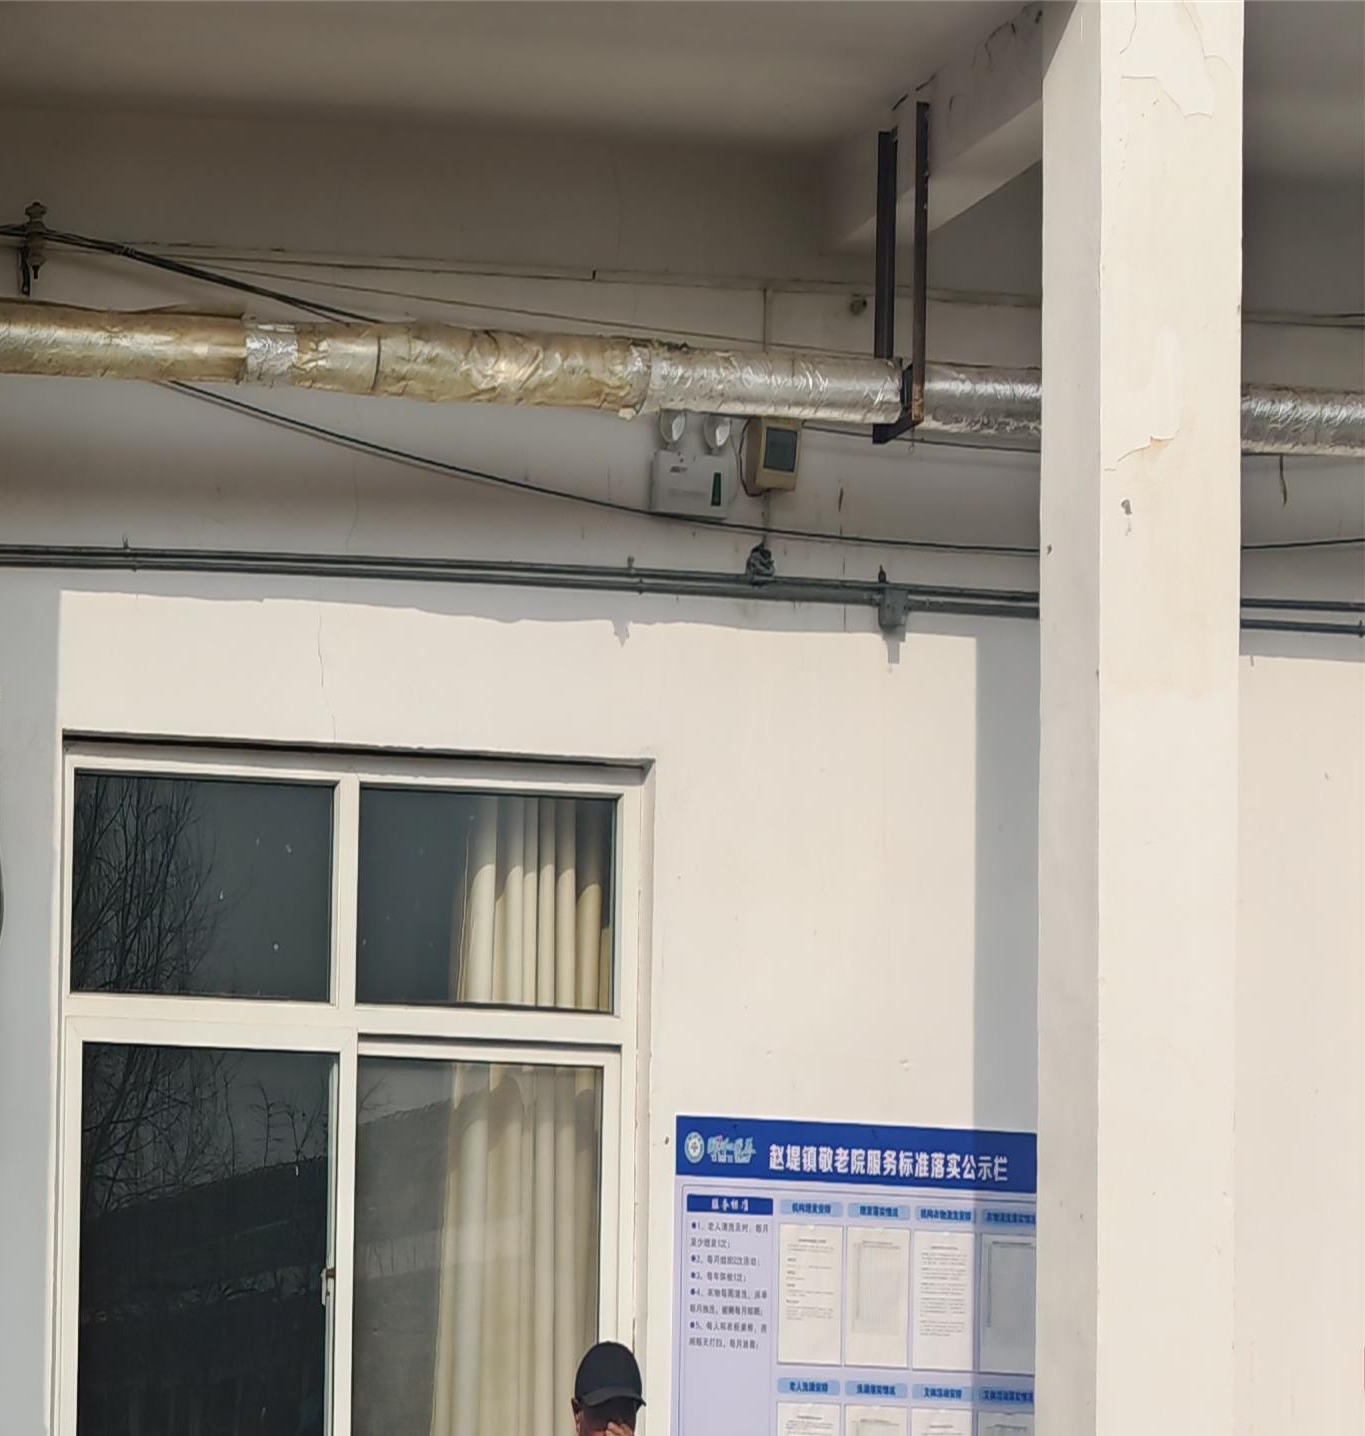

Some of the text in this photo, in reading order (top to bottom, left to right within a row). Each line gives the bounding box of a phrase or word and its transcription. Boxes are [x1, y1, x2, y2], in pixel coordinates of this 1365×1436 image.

[769, 1143, 1009, 1182] 赵堤镇敬老院服务标准落实公示栏
